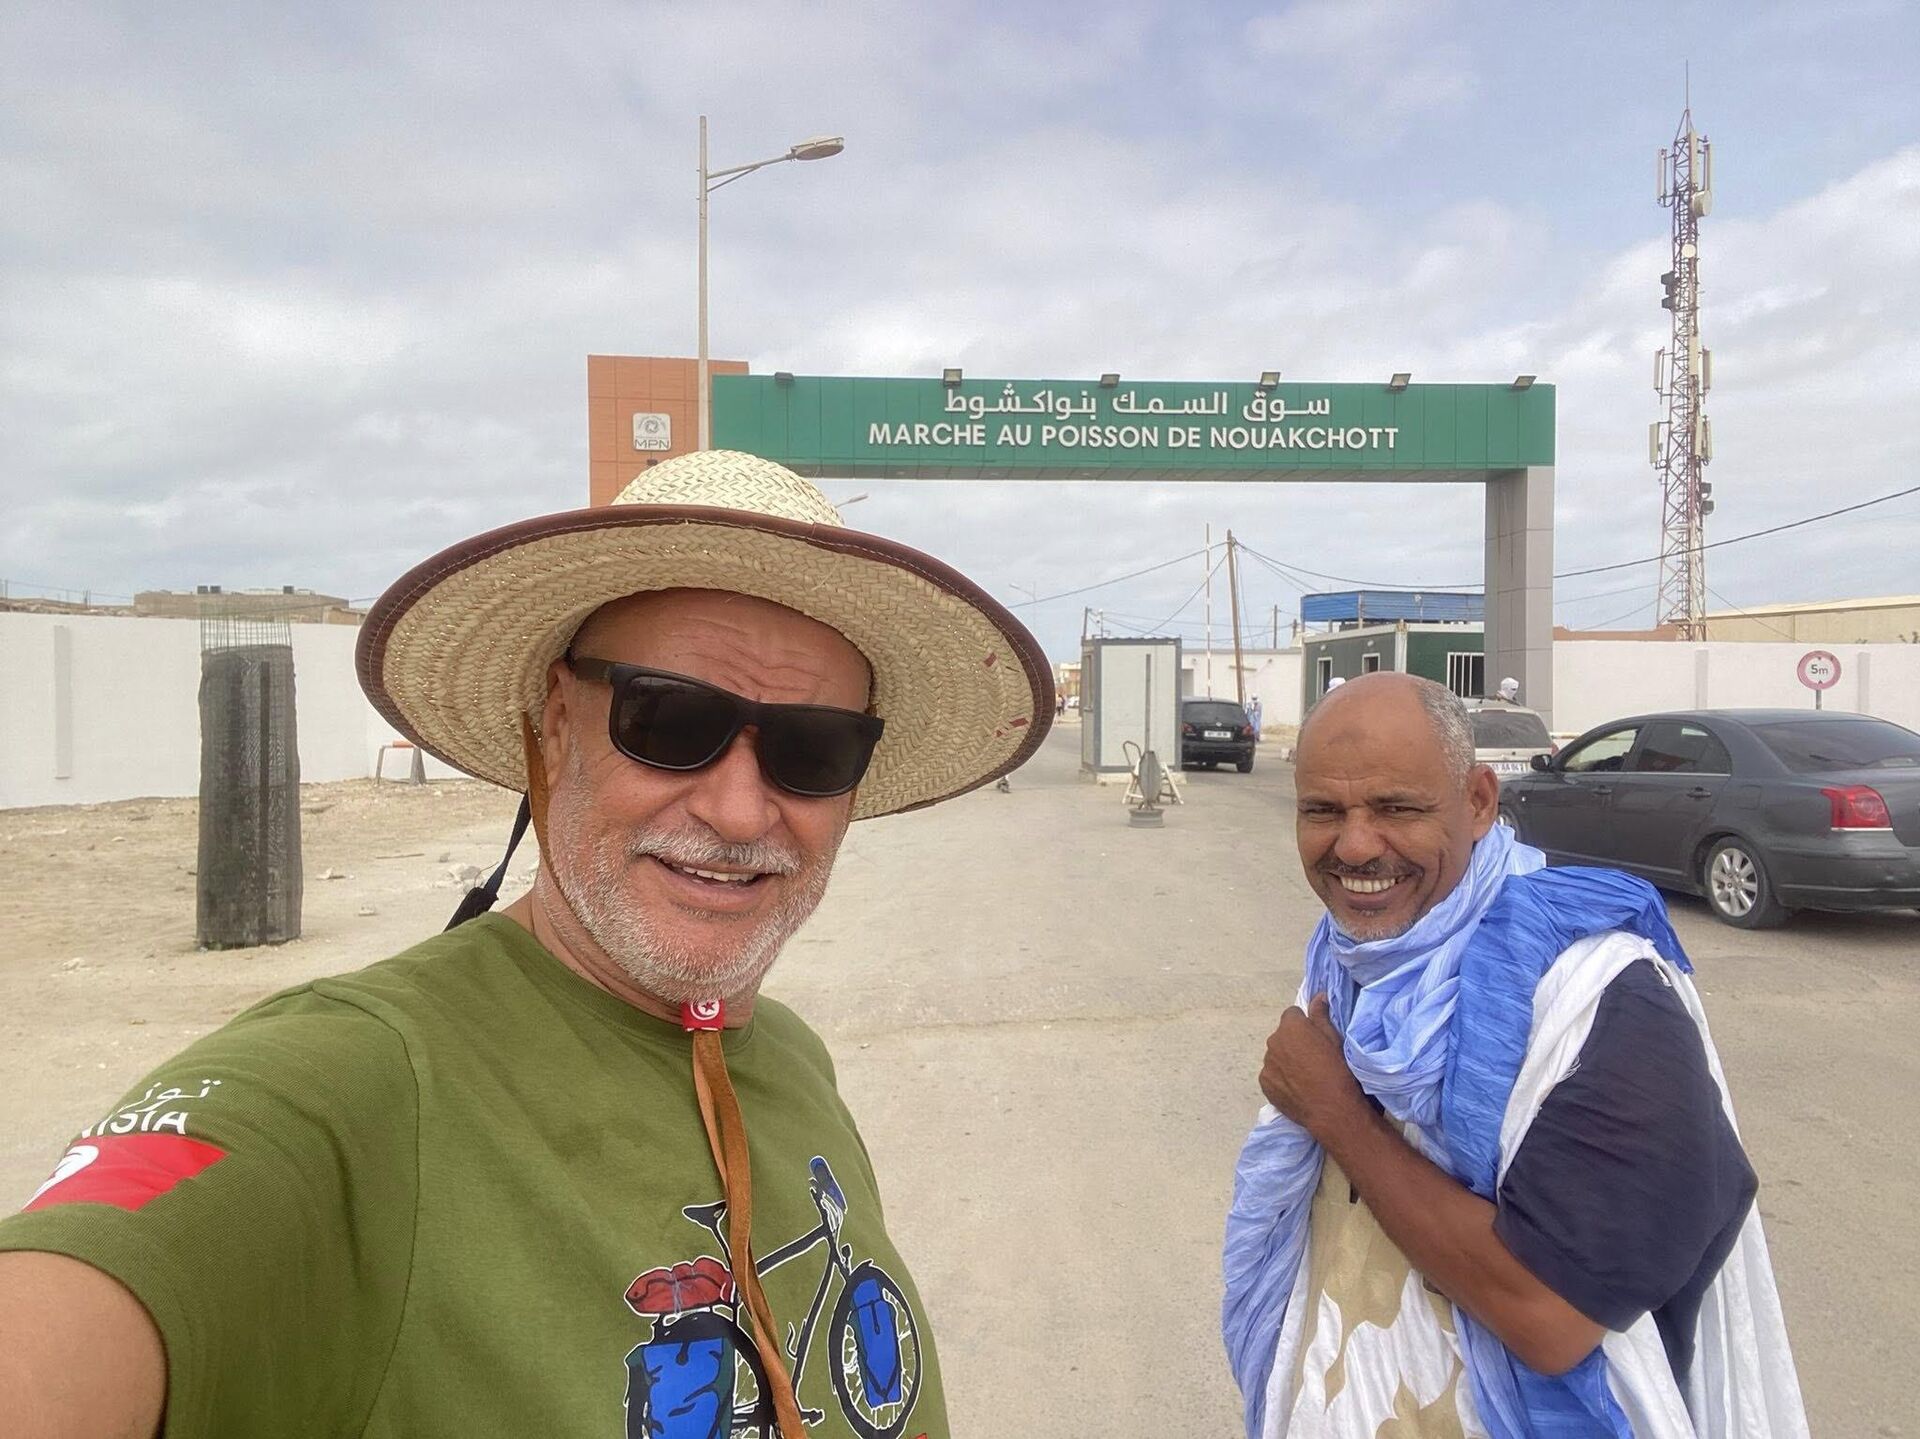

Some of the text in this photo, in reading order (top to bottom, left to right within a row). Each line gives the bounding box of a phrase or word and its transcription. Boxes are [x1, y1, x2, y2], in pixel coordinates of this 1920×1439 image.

[944, 383, 1331, 422] سوق السمك بنواكشوط
[634, 439, 670, 449] MPN
[868, 422, 1400, 449] MARCHE AU POISSON DE NOUAKCHOTT
[1811, 664, 1828, 674] 5m
